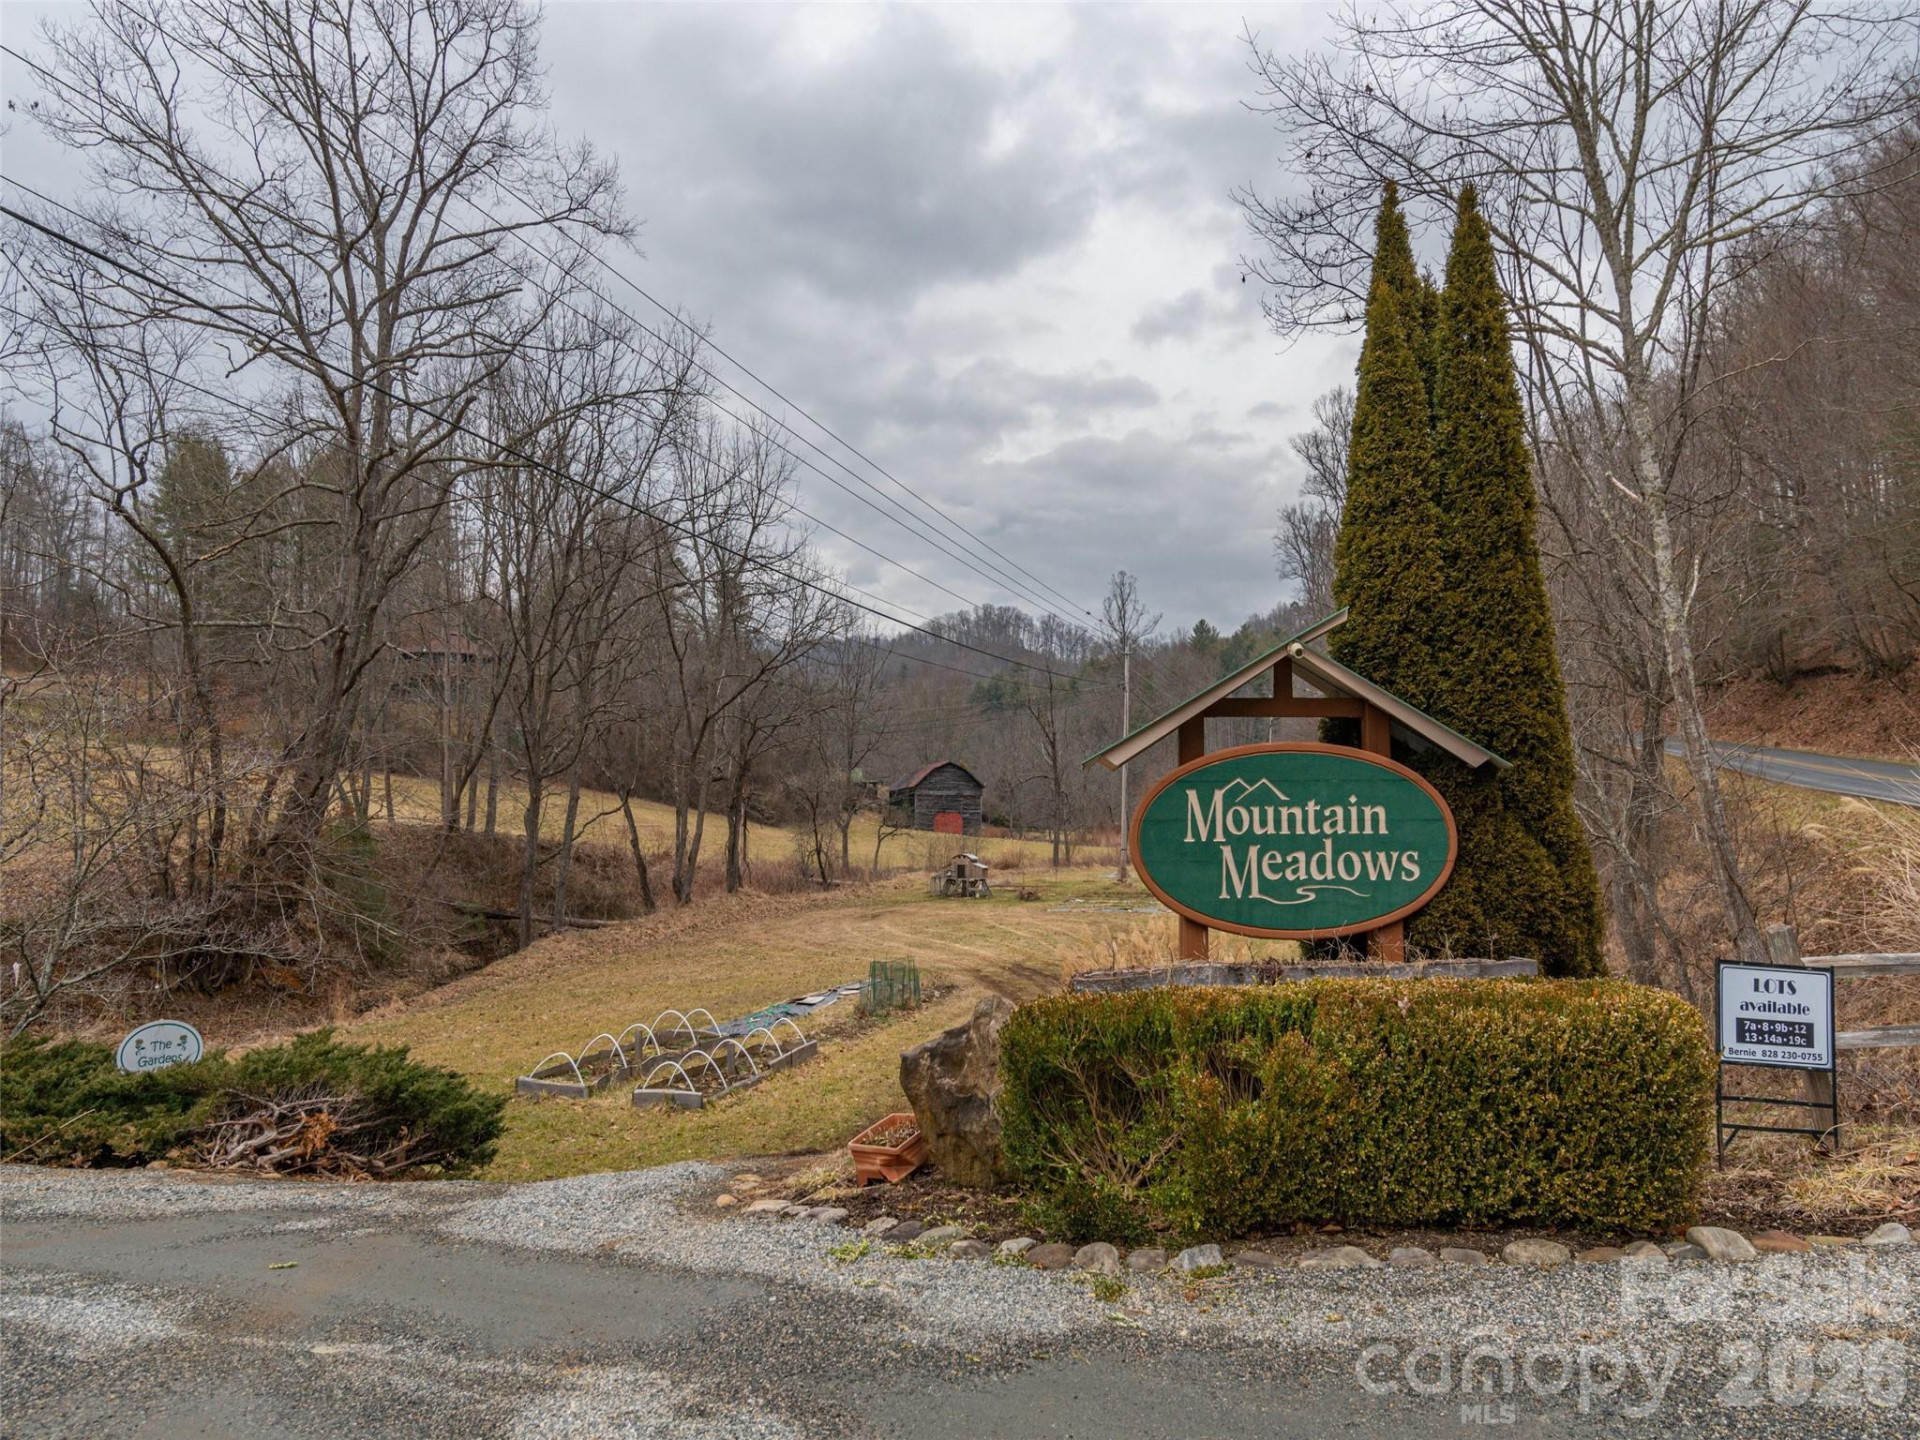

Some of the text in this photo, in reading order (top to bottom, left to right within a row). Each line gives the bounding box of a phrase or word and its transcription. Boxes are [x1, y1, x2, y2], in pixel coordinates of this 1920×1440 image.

[1184, 788, 1389, 843] Mountain
[1218, 837, 1421, 900] Meadows
[1753, 977, 1797, 996] LOTS
[1739, 1000, 1810, 1016] available
[150, 1040, 172, 1052] The
[1728, 1047, 1823, 1061] Bernie 828 230-0755
[137, 1053, 182, 1068] Gardens
